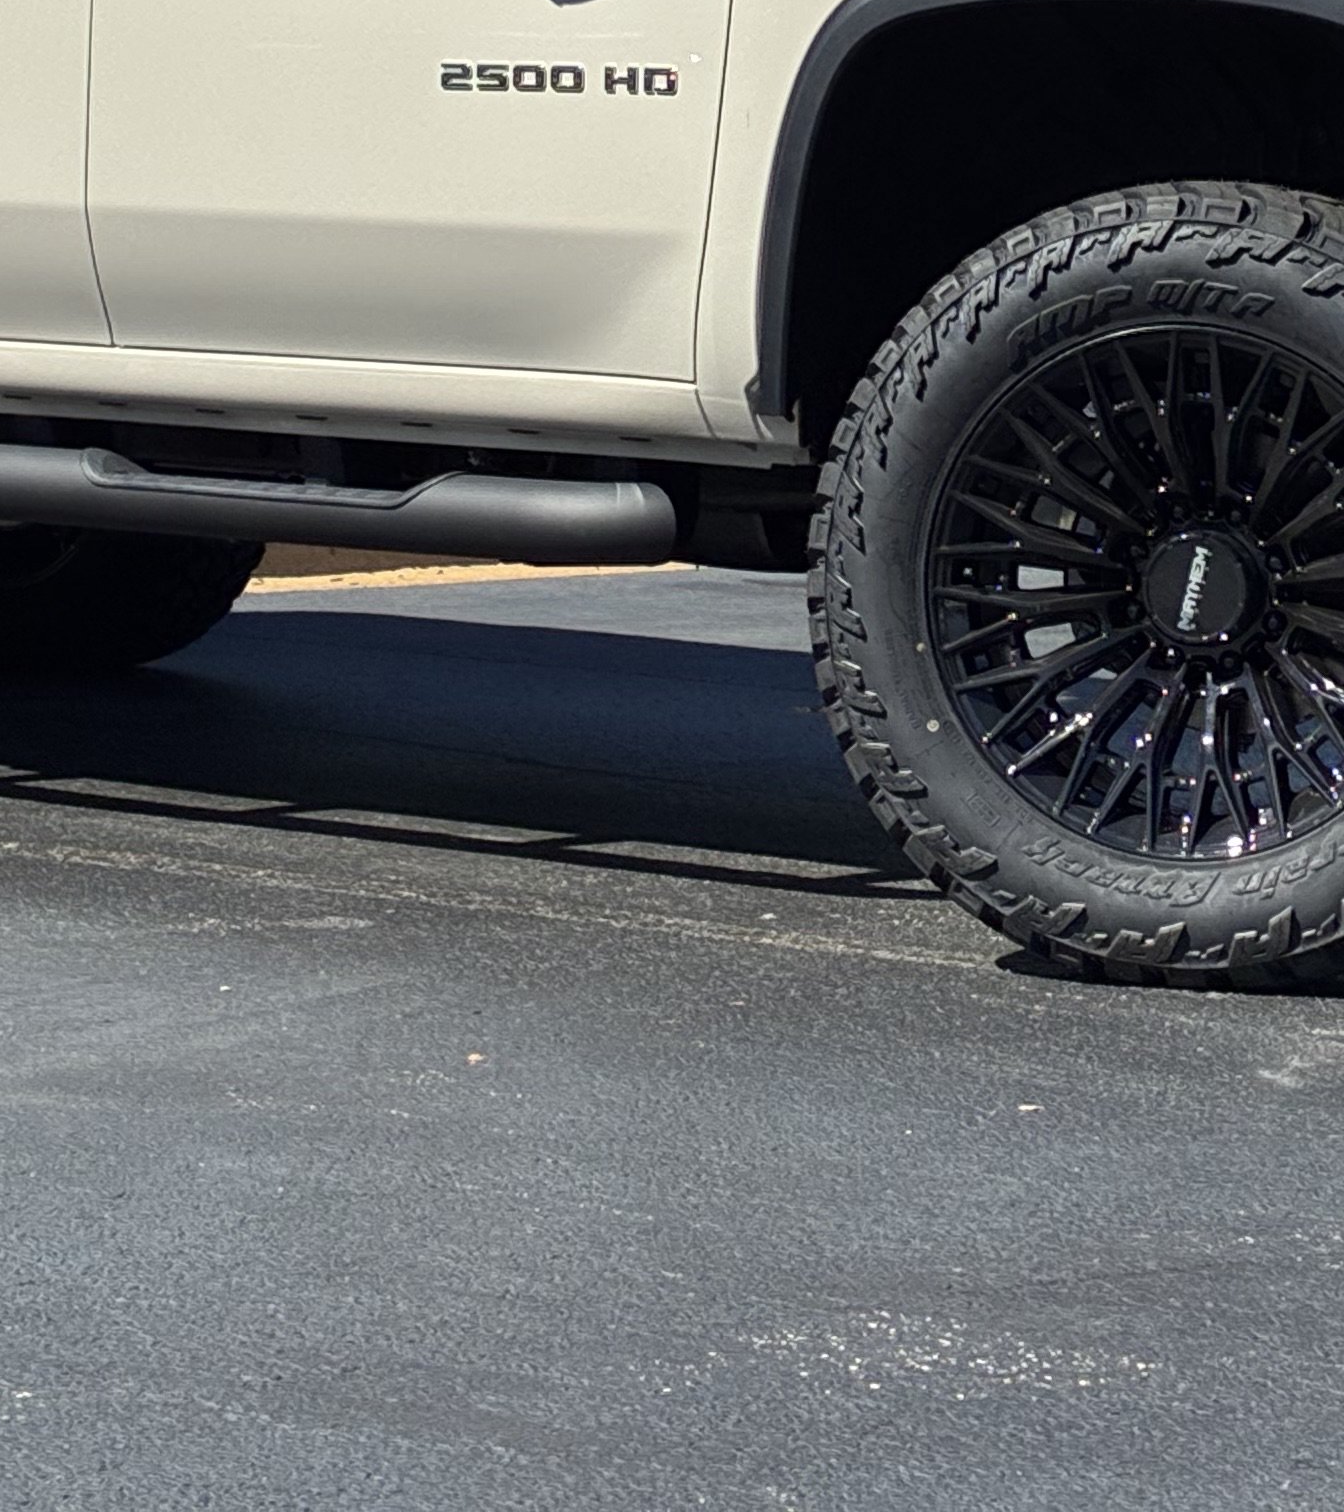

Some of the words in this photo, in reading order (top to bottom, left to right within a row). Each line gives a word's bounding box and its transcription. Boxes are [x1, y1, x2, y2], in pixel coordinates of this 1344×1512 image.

[441, 62, 585, 93] 2500
[604, 65, 679, 96] HD
[1177, 546, 1213, 631] MAYHEM
